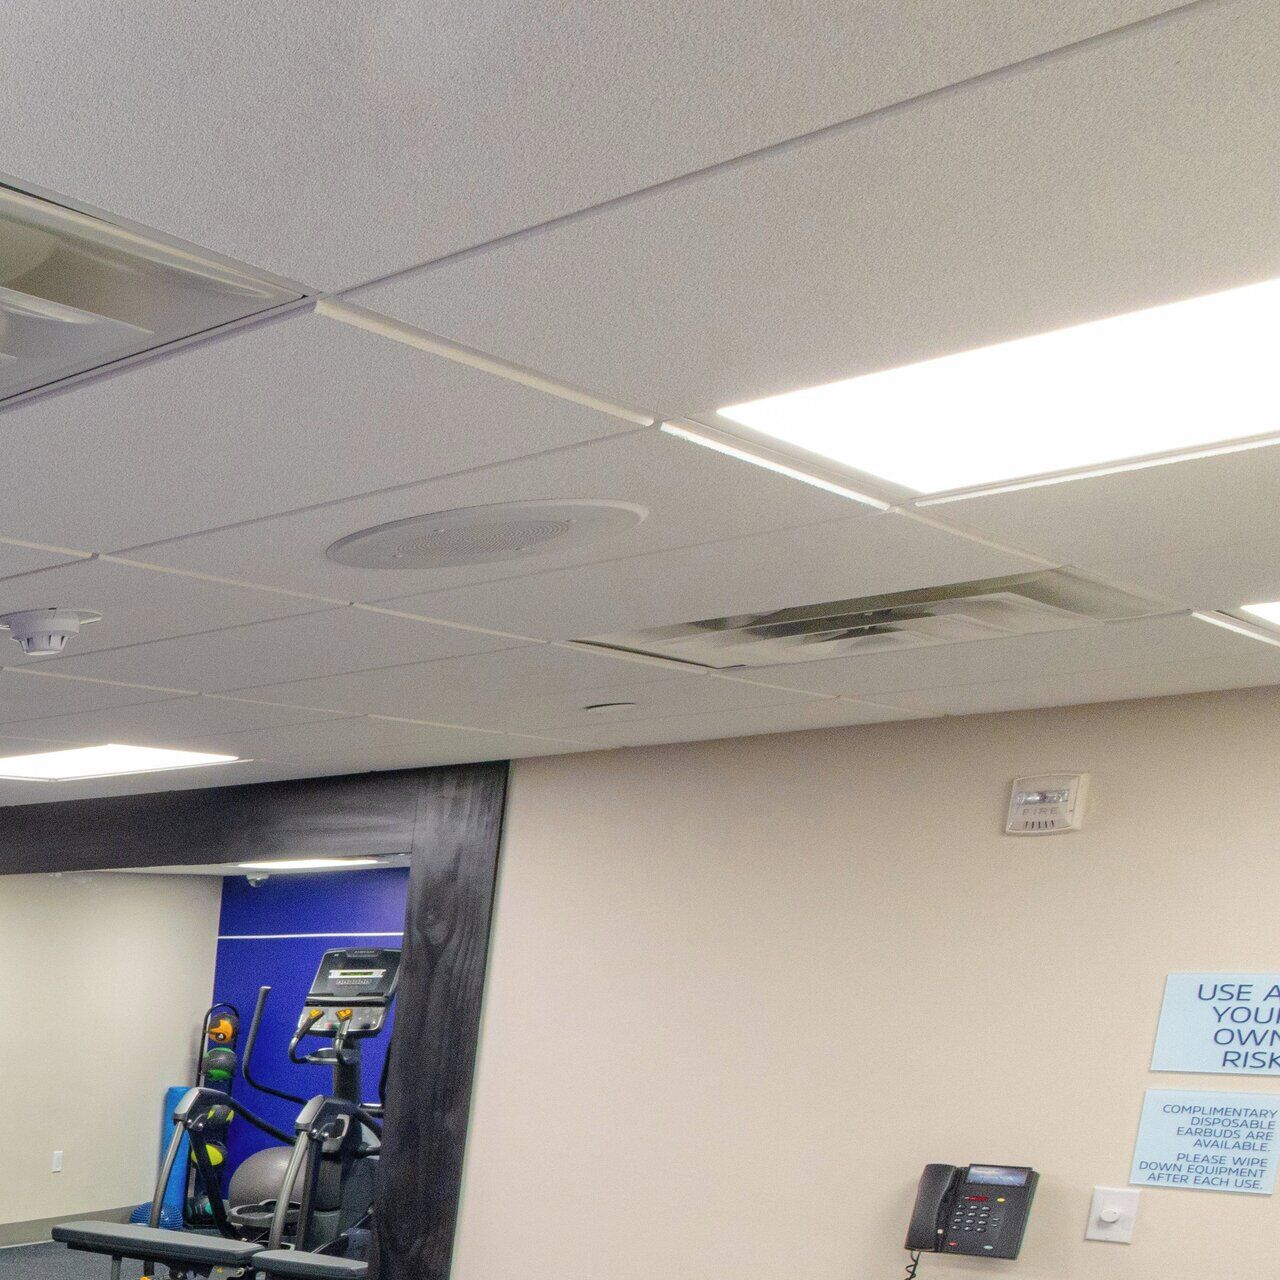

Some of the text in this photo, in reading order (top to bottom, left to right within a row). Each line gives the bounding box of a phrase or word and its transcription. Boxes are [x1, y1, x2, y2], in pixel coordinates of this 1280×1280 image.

[1198, 983, 1280, 1001] USE A
[1212, 1006, 1280, 1024] YOU
[1222, 1050, 1280, 1069] RISK
[1162, 1104, 1278, 1119] COMPLIMENTARY
[1190, 1116, 1276, 1130] DISPOSABLE
[1176, 1126, 1274, 1141] EARBUDS ARE
[1193, 1138, 1271, 1152] AVAILABLE.
[1176, 1152, 1268, 1168] PLEASE WIPE
[1139, 1160, 1267, 1178] DOWN EQUIPMENT
[1147, 1172, 1263, 1190] AFTER EACH USE.
